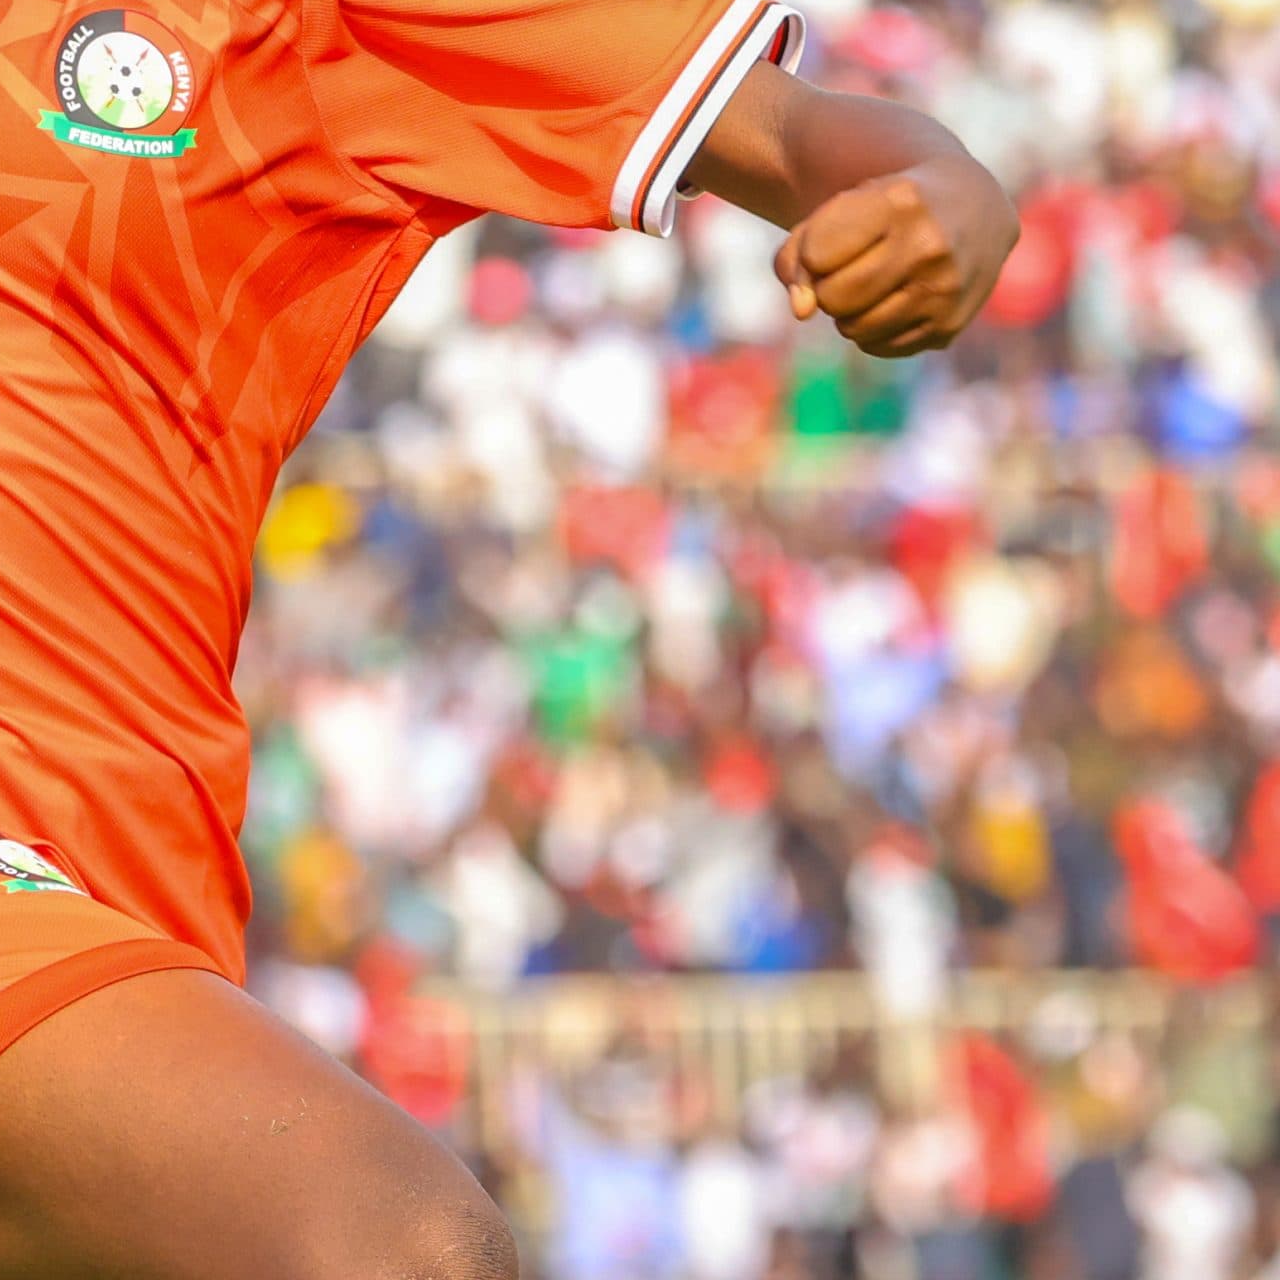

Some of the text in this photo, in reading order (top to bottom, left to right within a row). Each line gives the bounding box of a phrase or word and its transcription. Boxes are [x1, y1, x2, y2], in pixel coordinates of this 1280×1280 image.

[58, 24, 95, 112] FOOTBALL
[169, 50, 191, 113] KENYA
[68, 127, 173, 154] FEDERATION
